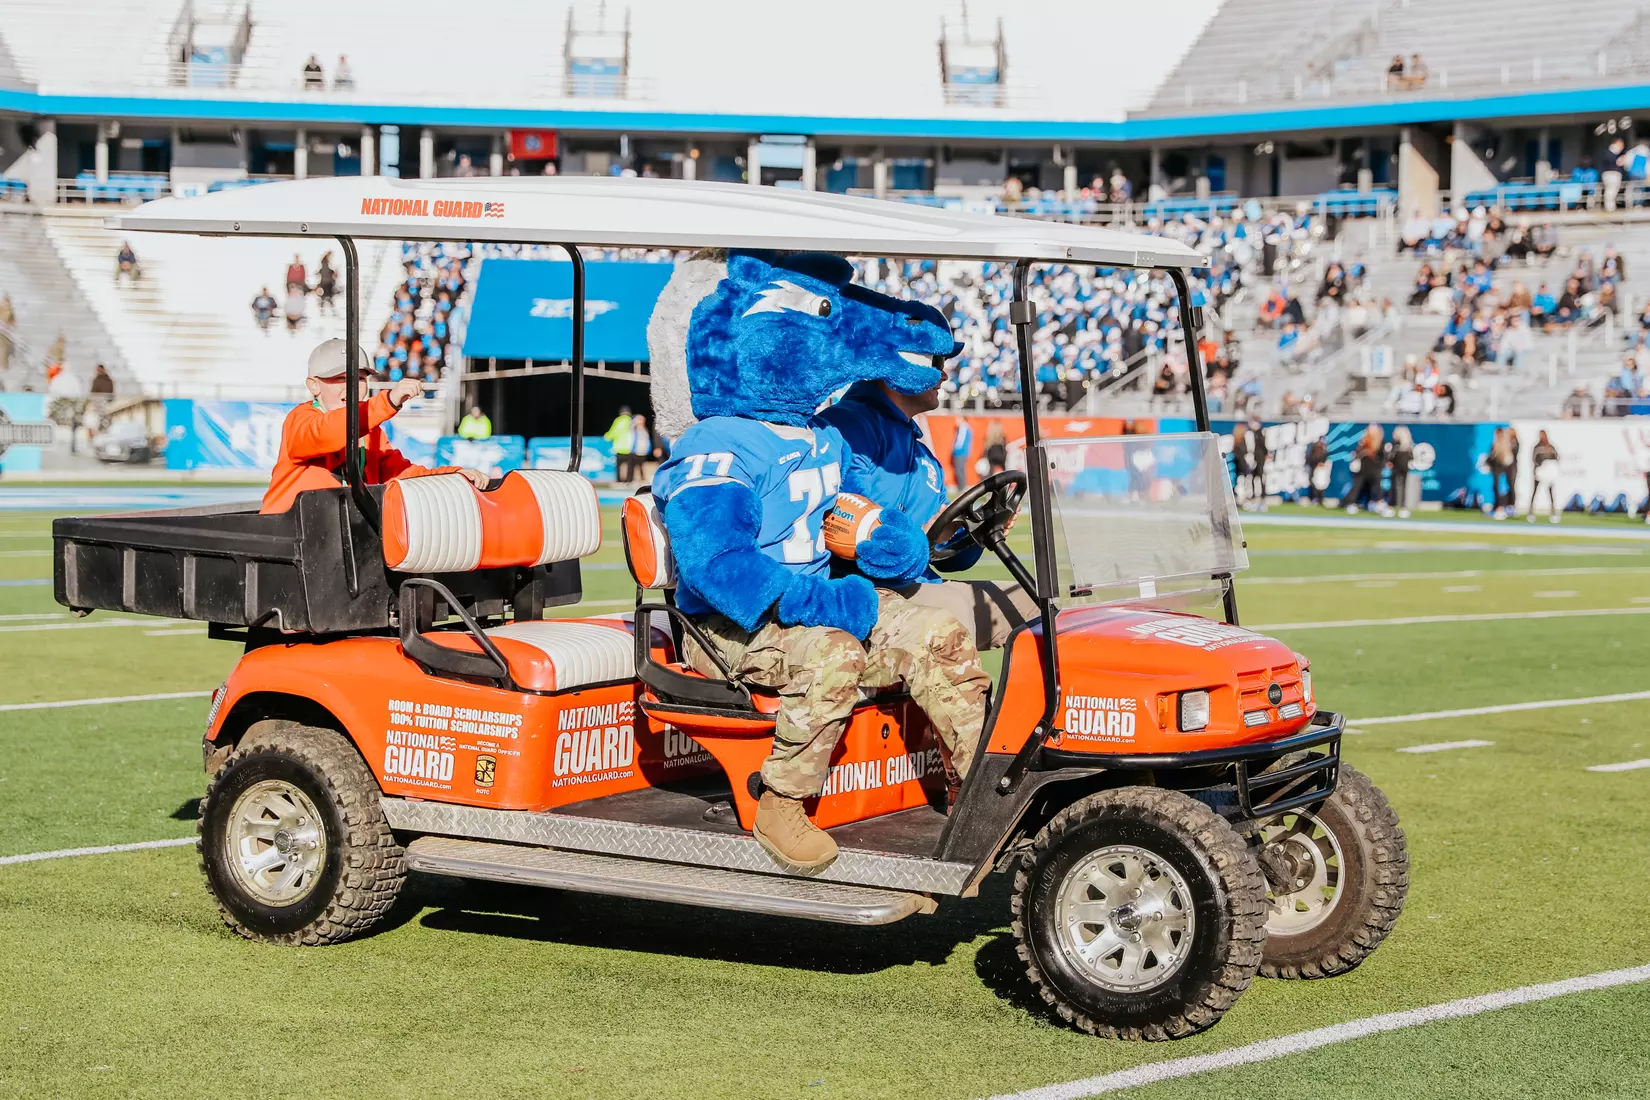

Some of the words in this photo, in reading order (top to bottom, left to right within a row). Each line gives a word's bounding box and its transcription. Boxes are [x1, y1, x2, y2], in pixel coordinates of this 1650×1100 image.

[361, 198, 429, 216] NATIONAL
[433, 200, 483, 218] GUARD
[684, 452, 734, 481] 77
[388, 699, 414, 713] ROOM
[415, 703, 422, 713] &
[423, 704, 452, 718] BOARD
[453, 708, 523, 726] SCHOLARSHIPS
[1065, 695, 1120, 711] NATIONAL
[390, 713, 413, 726] 100%
[415, 716, 448, 731] TUITION
[450, 720, 519, 739] SCHOLARSHIPS
[558, 703, 619, 731] NATIONAL
[1065, 708, 1136, 737] GUARD
[386, 730, 440, 750] NATIONAL
[459, 744, 480, 752] NATIONAL
[553, 725, 635, 777] GUARD
[1066, 734, 1136, 744] NATIONALGUARD.com
[384, 746, 455, 782] GUARD
[821, 759, 882, 797] ATIONAL
[886, 751, 926, 786] GUARD
[383, 775, 452, 790] NATIONALGUARD.com
[552, 770, 634, 788] NATIONALGUARD.com
